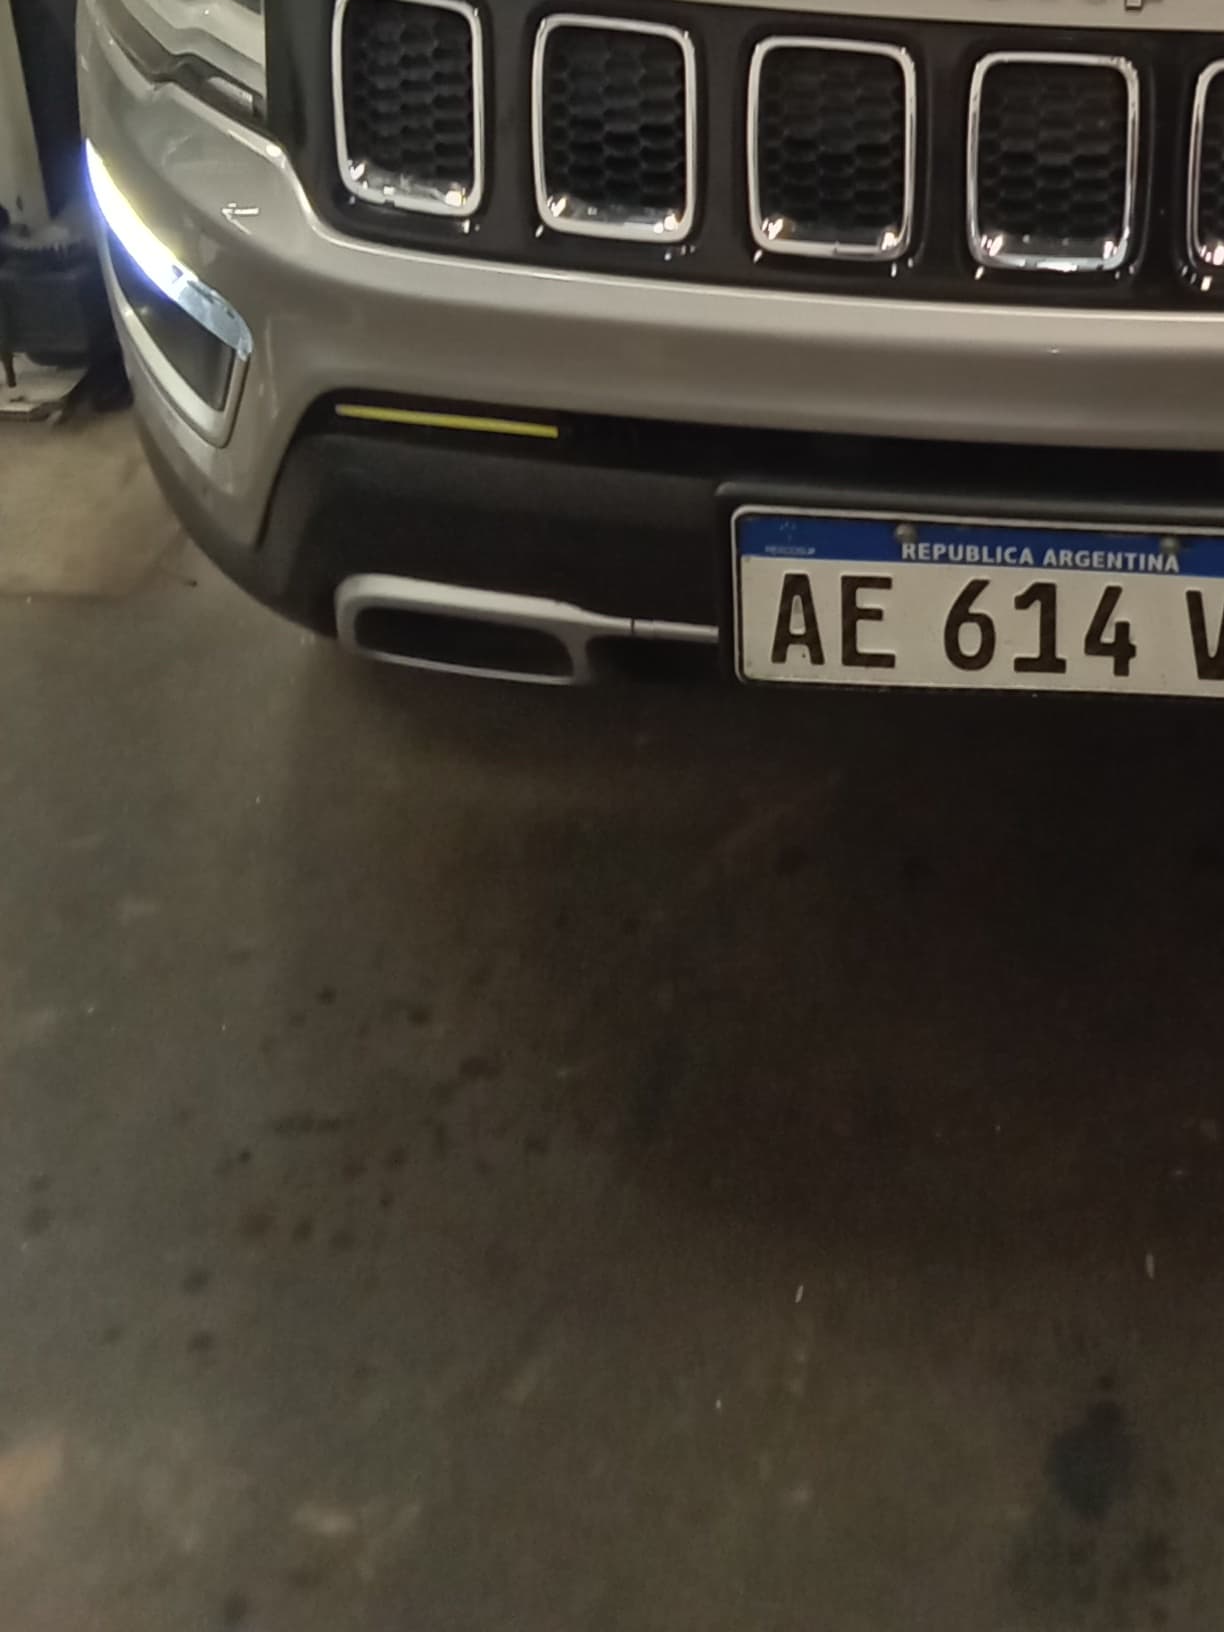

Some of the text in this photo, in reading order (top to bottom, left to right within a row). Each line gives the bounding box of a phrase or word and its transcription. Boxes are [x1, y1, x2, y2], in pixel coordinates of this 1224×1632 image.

[902, 542, 1179, 573] REPUBLICA ARGENTINA
[771, 572, 896, 668] AE
[943, 578, 1136, 677] 614
